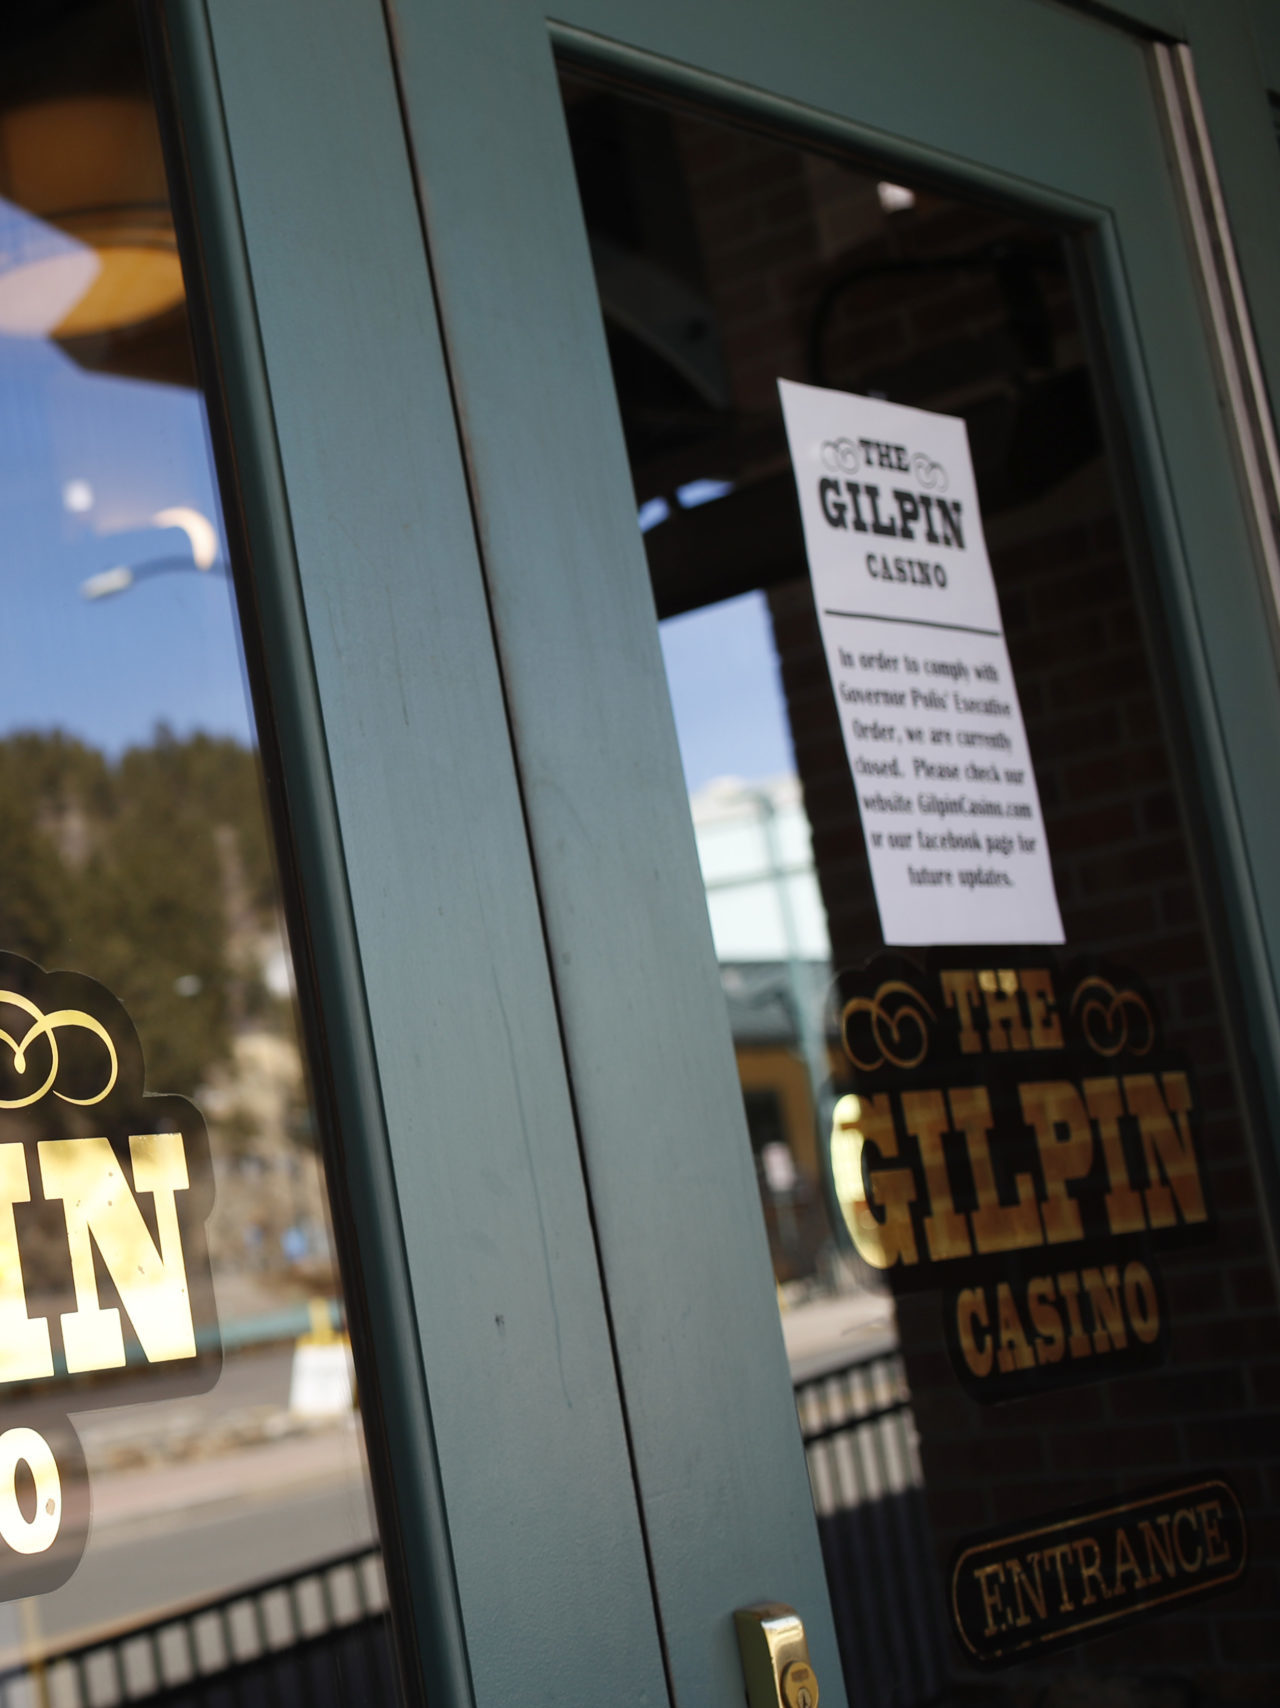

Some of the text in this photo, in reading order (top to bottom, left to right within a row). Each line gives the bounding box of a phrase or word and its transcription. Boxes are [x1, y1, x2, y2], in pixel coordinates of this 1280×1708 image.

[860, 438, 909, 472] THE
[819, 477, 965, 550] GILPIN
[866, 553, 948, 589] CASINO
[860, 653, 898, 669] order
[905, 656, 918, 672] to
[925, 661, 967, 680] comply
[975, 665, 998, 681] with
[840, 684, 904, 705] Governor
[954, 694, 1010, 714] Executive
[853, 720, 1011, 752] Order, we are currently
[914, 760, 959, 779] Please
[966, 765, 999, 781] check
[940, 968, 1065, 1054] THE
[830, 1070, 1208, 1270] GILPIN
[957, 1260, 1160, 1377] CASINO
[974, 1500, 1231, 1638] ENTRANCE
